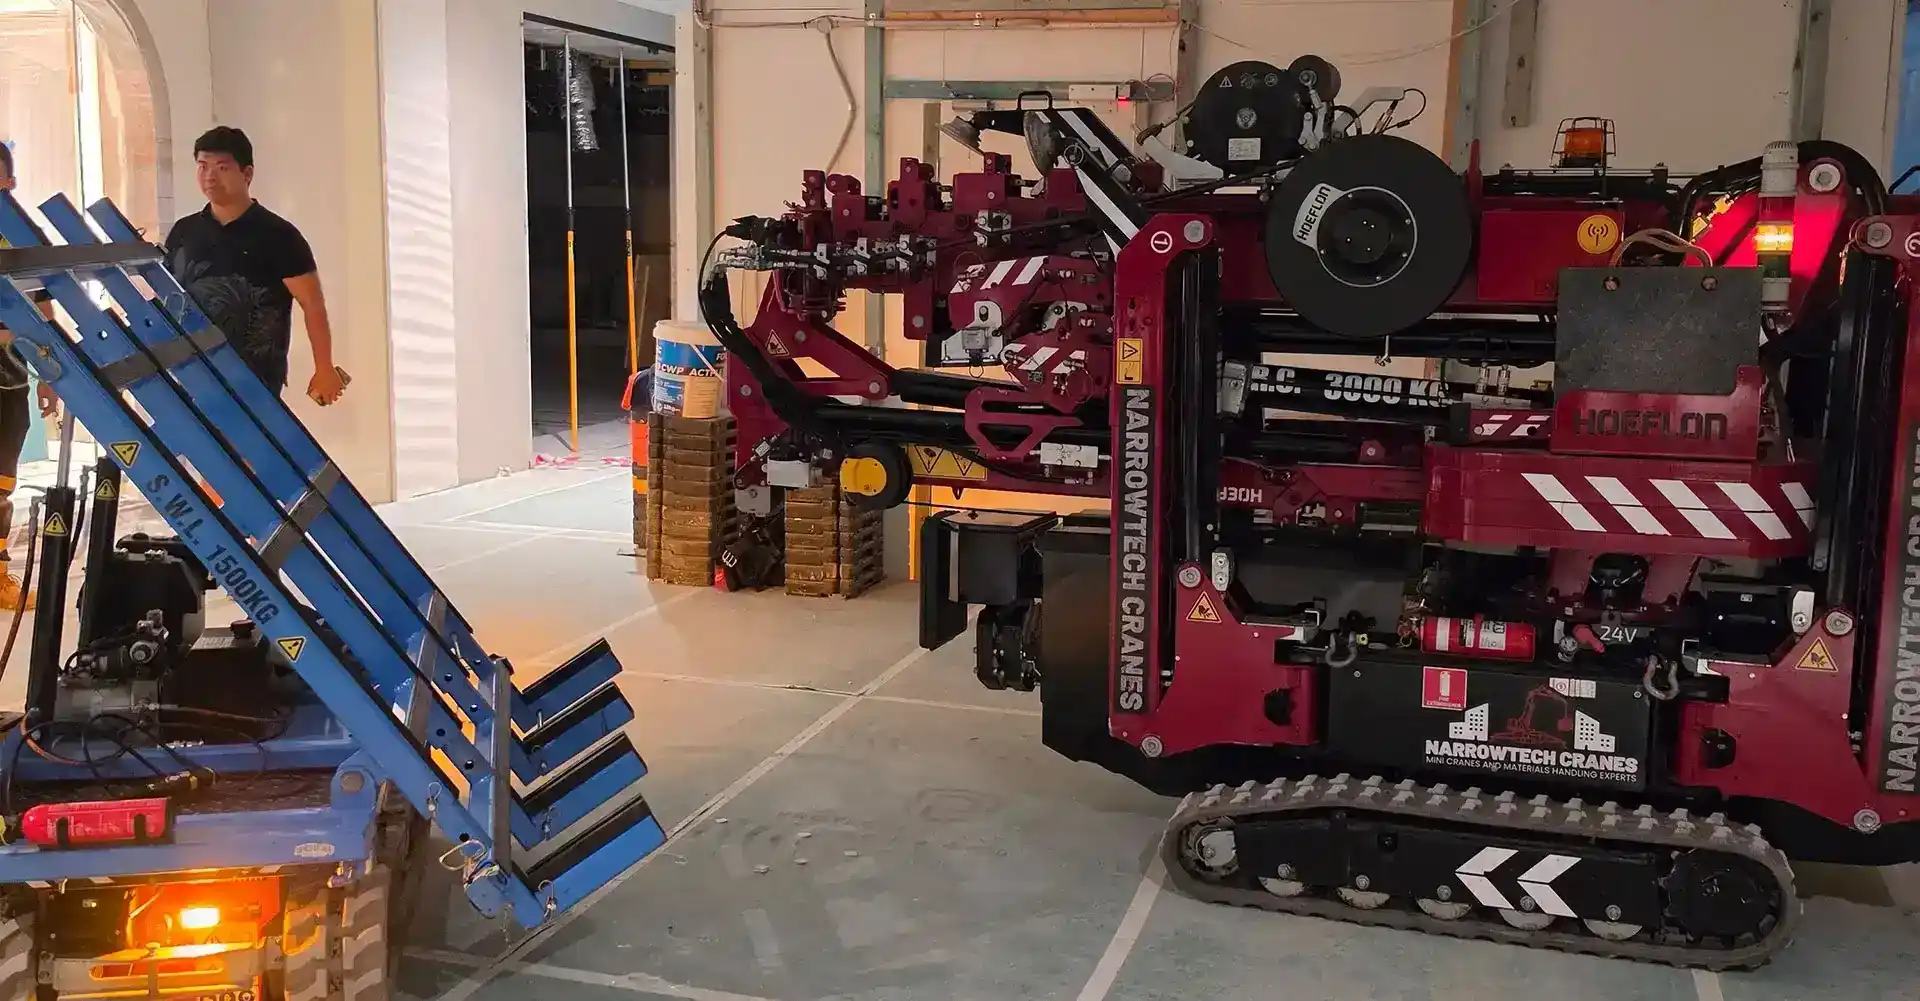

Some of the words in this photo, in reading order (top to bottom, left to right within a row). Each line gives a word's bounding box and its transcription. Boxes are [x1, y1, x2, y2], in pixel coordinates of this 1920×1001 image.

[1297, 186, 1331, 241] HOEFLON
[1324, 373, 1402, 405] 3000
[1573, 409, 1728, 440] HOEFLON
[1122, 389, 1150, 591] NARROWTECH
[205, 543, 279, 625] 1500KG
[1600, 626, 1637, 644] 24V
[1120, 596, 1146, 711] CRANES
[1425, 740, 1557, 766] NARROWTECH
[1559, 751, 1639, 773] CRANES
[1426, 756, 1444, 764] MINI
[1446, 757, 1481, 768] CRANES
[1482, 760, 1501, 769] AND
[1503, 763, 1550, 774] MATERIALS
[1552, 767, 1598, 779] HANDLING
[1600, 771, 1637, 783] EXPERTS
